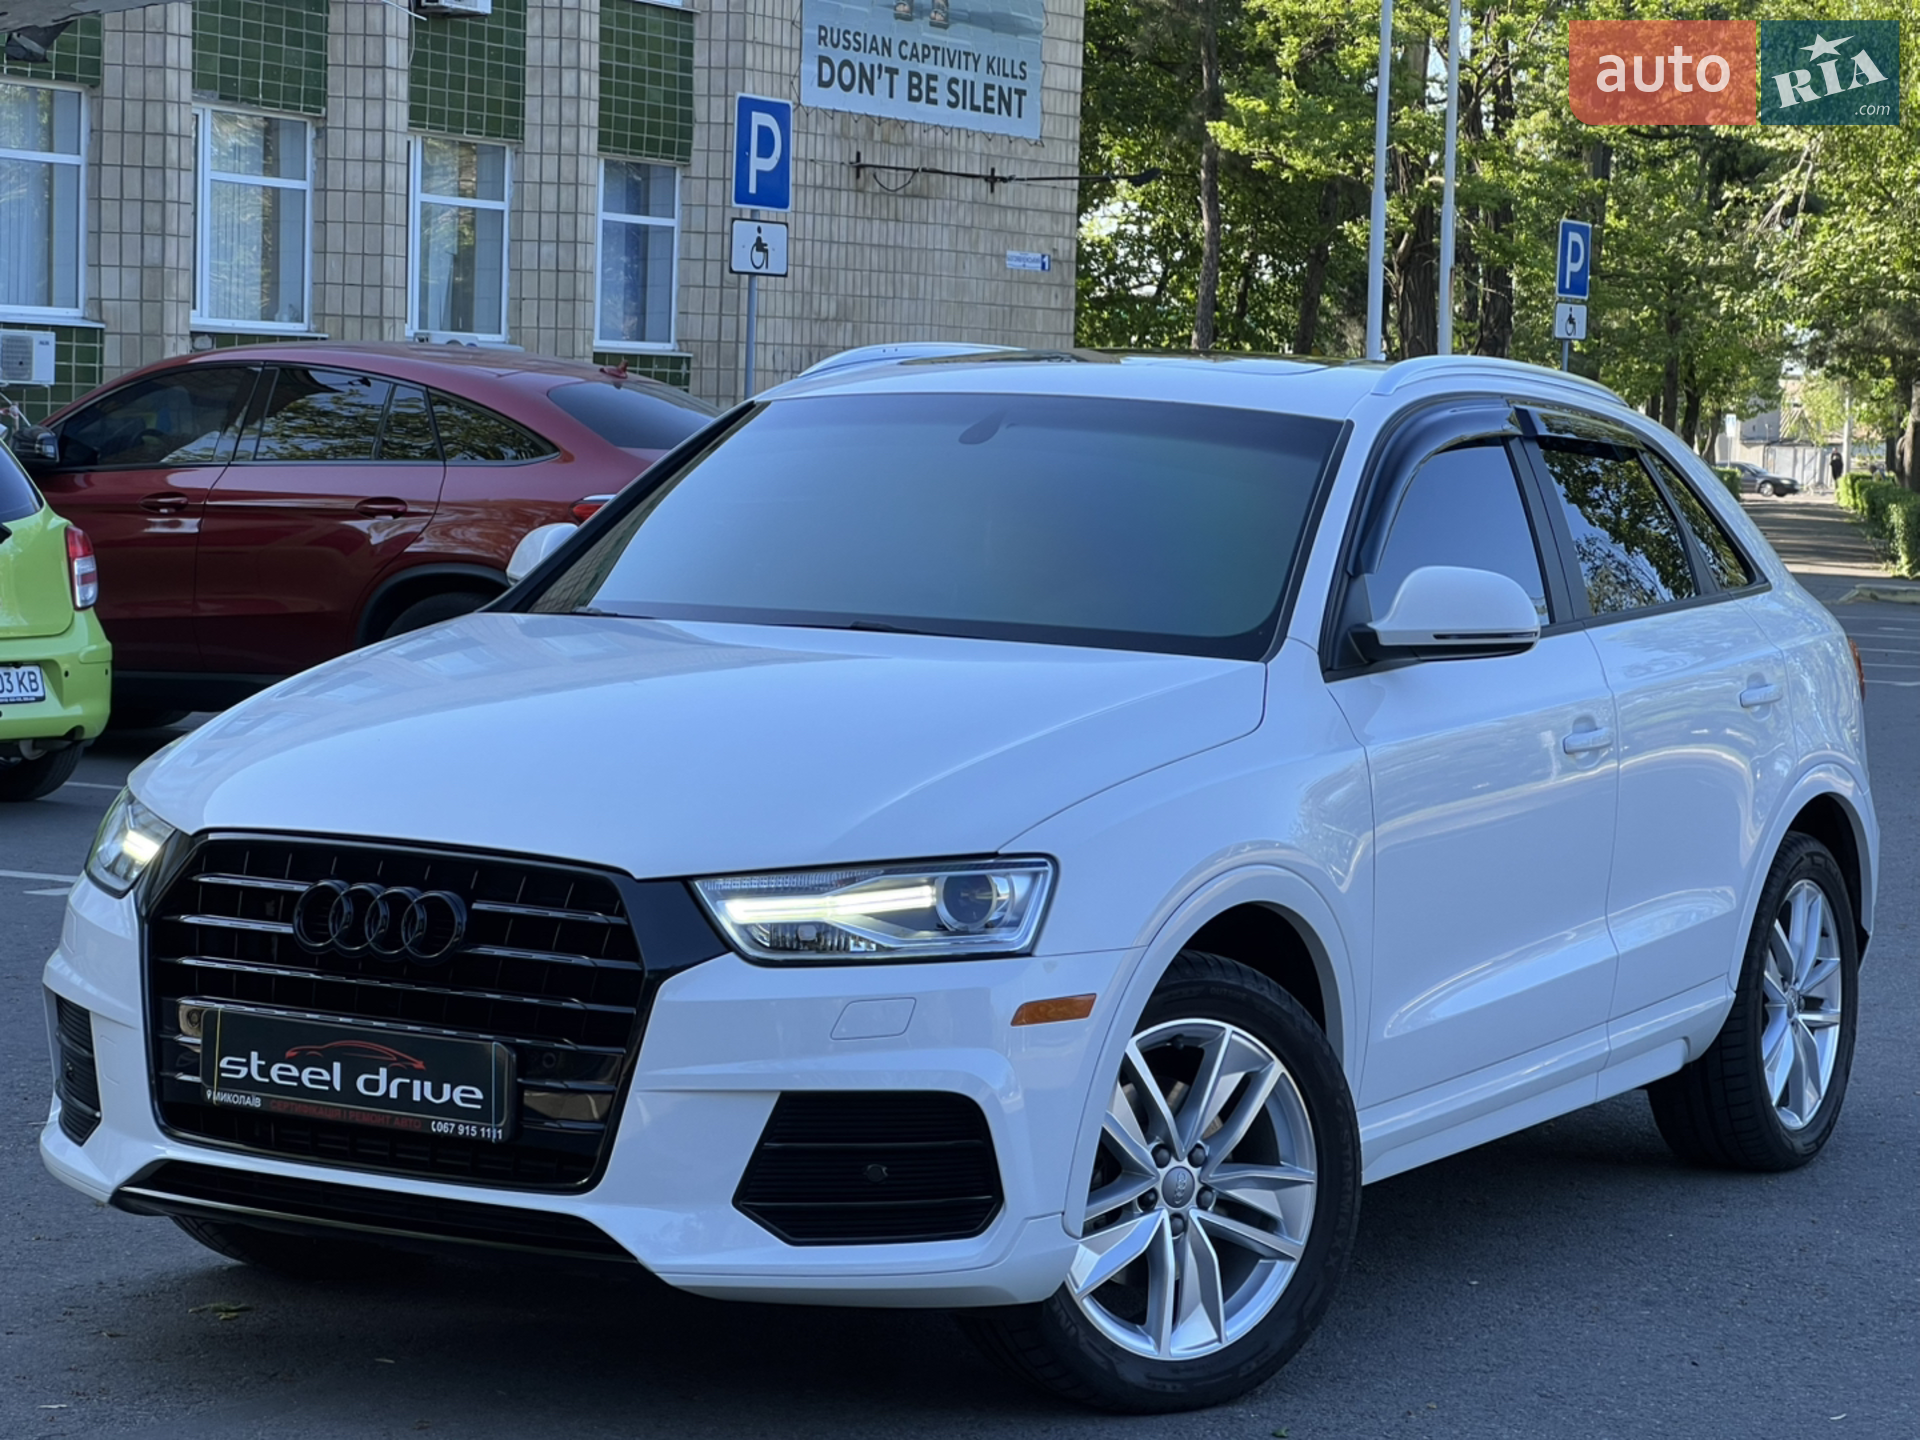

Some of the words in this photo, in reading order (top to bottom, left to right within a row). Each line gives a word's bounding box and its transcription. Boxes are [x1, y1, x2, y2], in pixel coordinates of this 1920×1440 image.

[818, 25, 892, 58] RUSSIAN
[898, 39, 981, 73] CAPTIVITY
[986, 55, 1027, 81] KILLS
[817, 54, 899, 99] DON'T
[907, 70, 939, 106] BE
[946, 76, 1028, 119] SILENT
[748, 111, 782, 194] P
[1565, 231, 1585, 290] P
[1209, 986, 1248, 1001] OUTSIDE
[219, 1051, 341, 1092] steel
[356, 1067, 484, 1110] drive
[437, 1121, 455, 1133] 067
[458, 1124, 477, 1136] 915
[1324, 1129, 1353, 1268] STARMAXX
